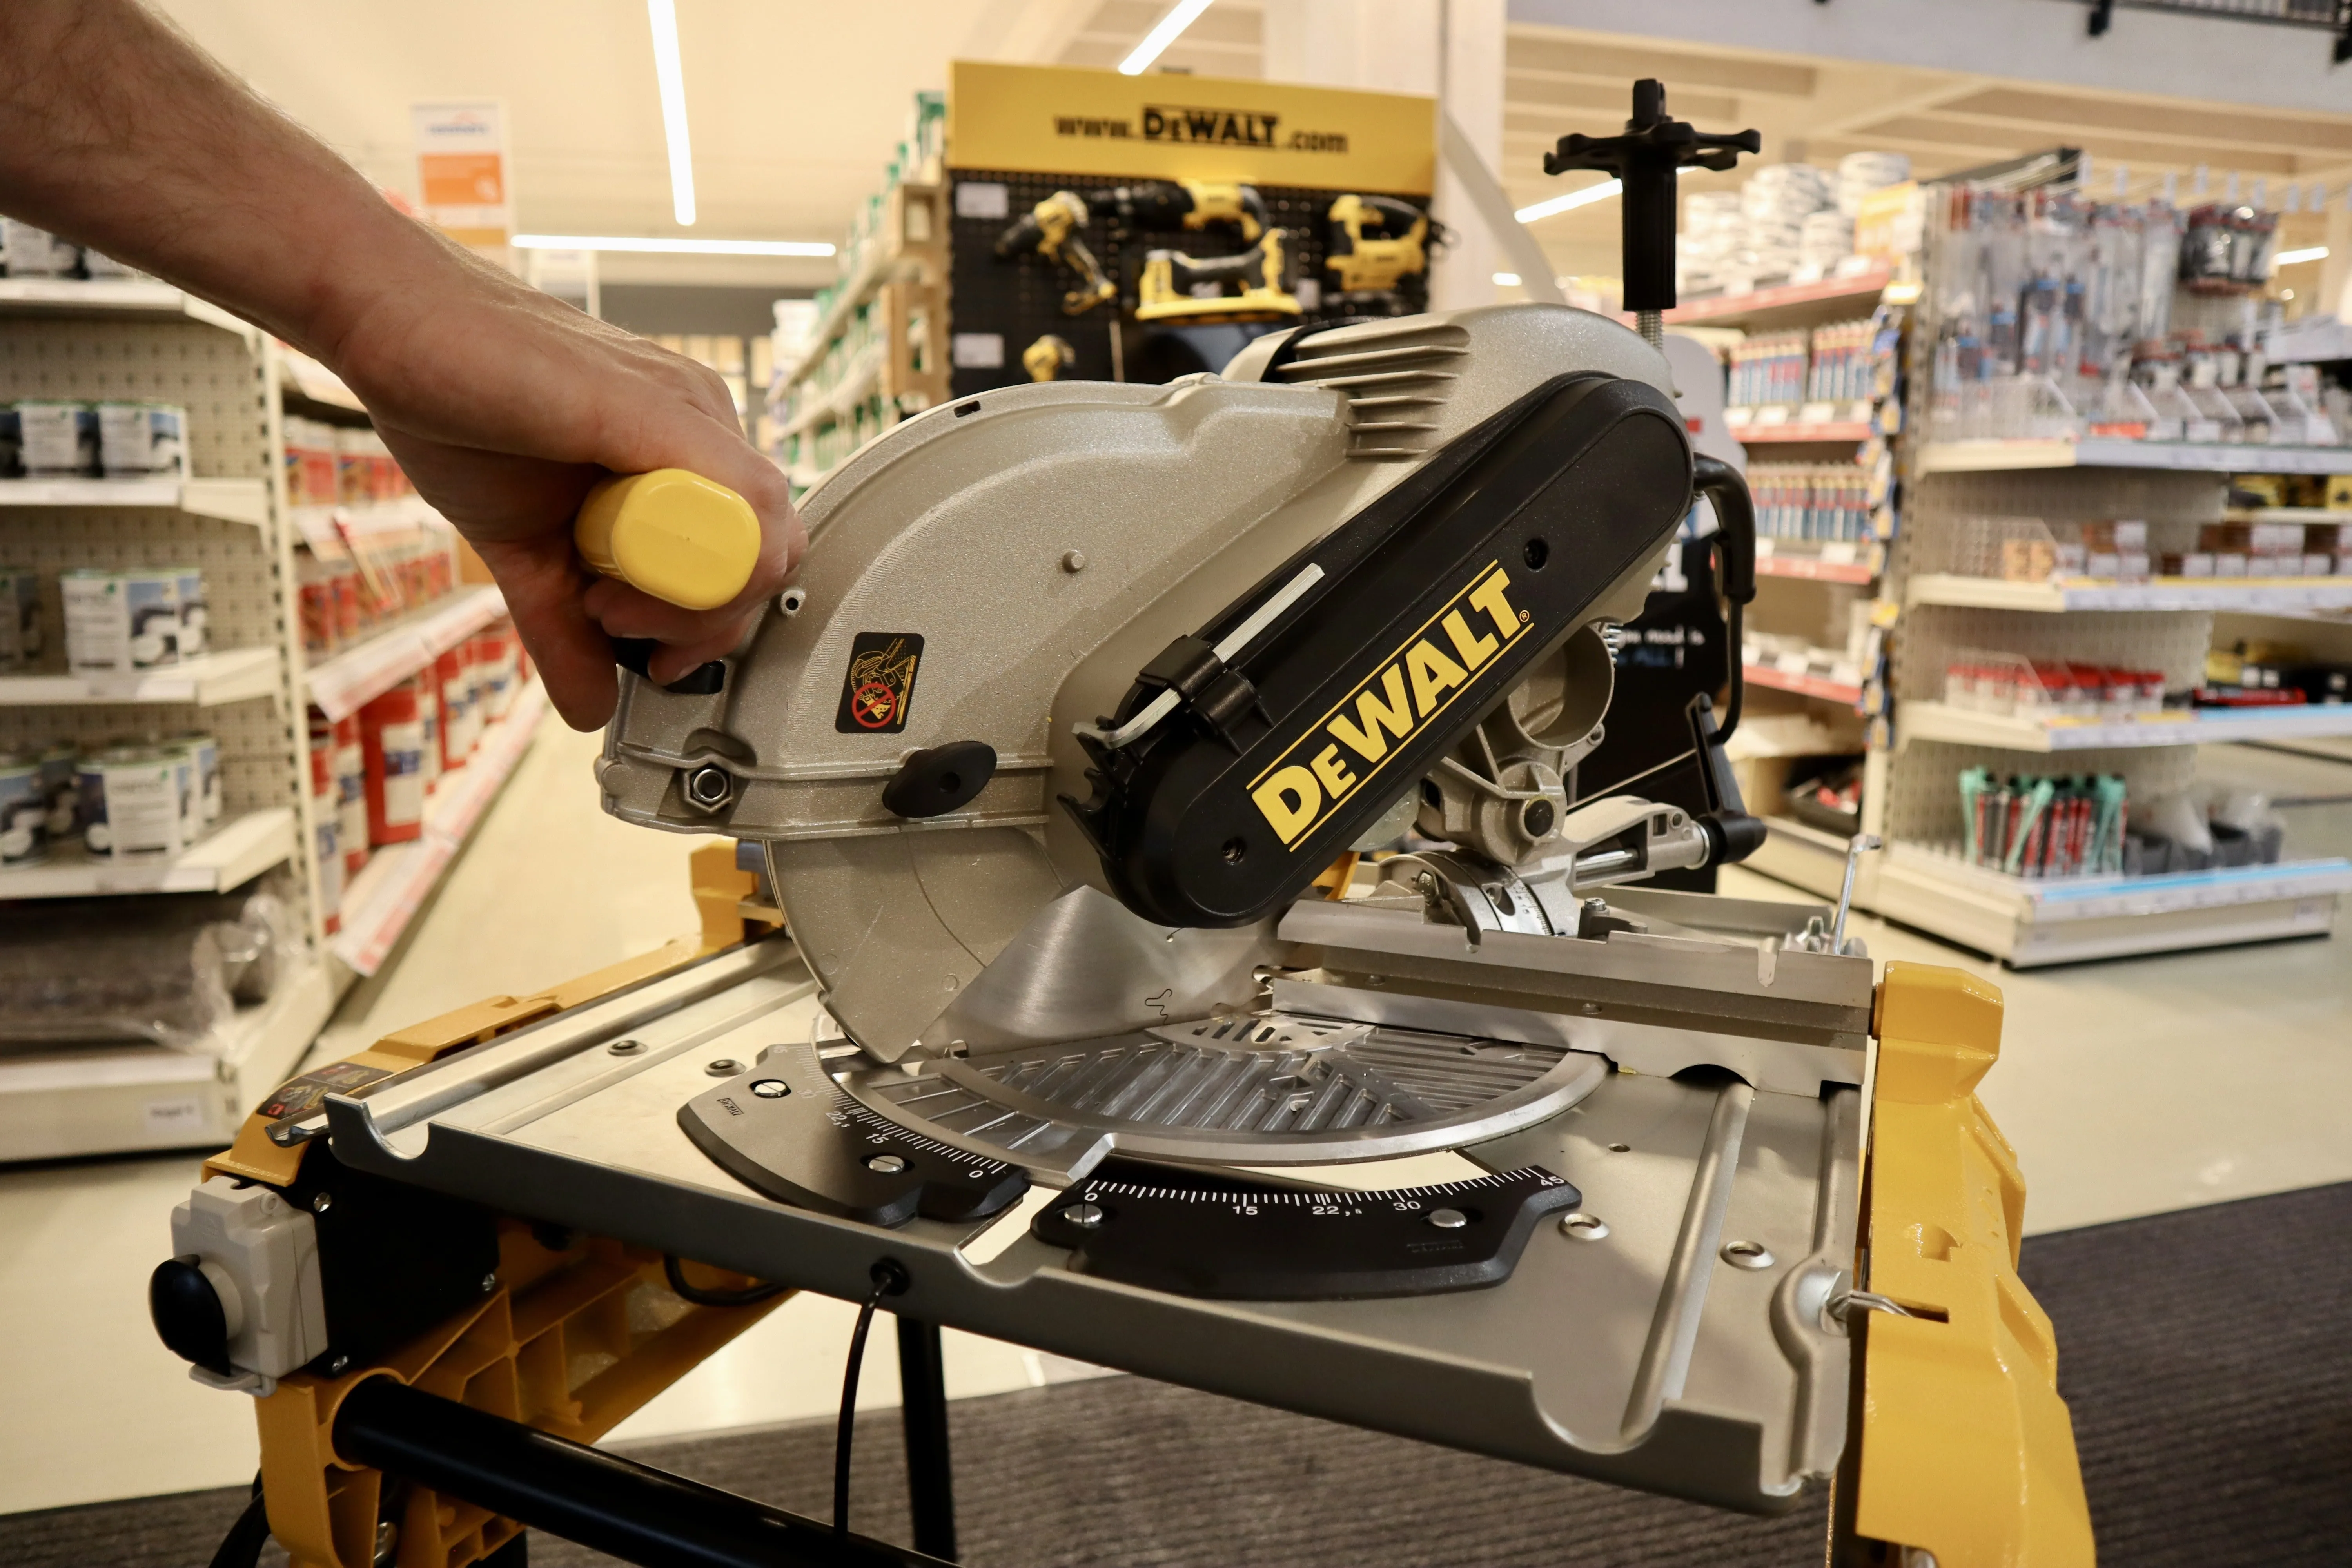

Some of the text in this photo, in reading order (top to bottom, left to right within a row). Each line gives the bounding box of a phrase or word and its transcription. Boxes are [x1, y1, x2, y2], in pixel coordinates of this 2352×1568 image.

[797, 1089, 817, 1098] 30
[866, 1133, 889, 1143] 15
[1085, 1192, 1098, 1201] 0
[1232, 1206, 1258, 1215] 15
[1393, 1201, 1421, 1211] 30
[1540, 1176, 1565, 1186] 45
